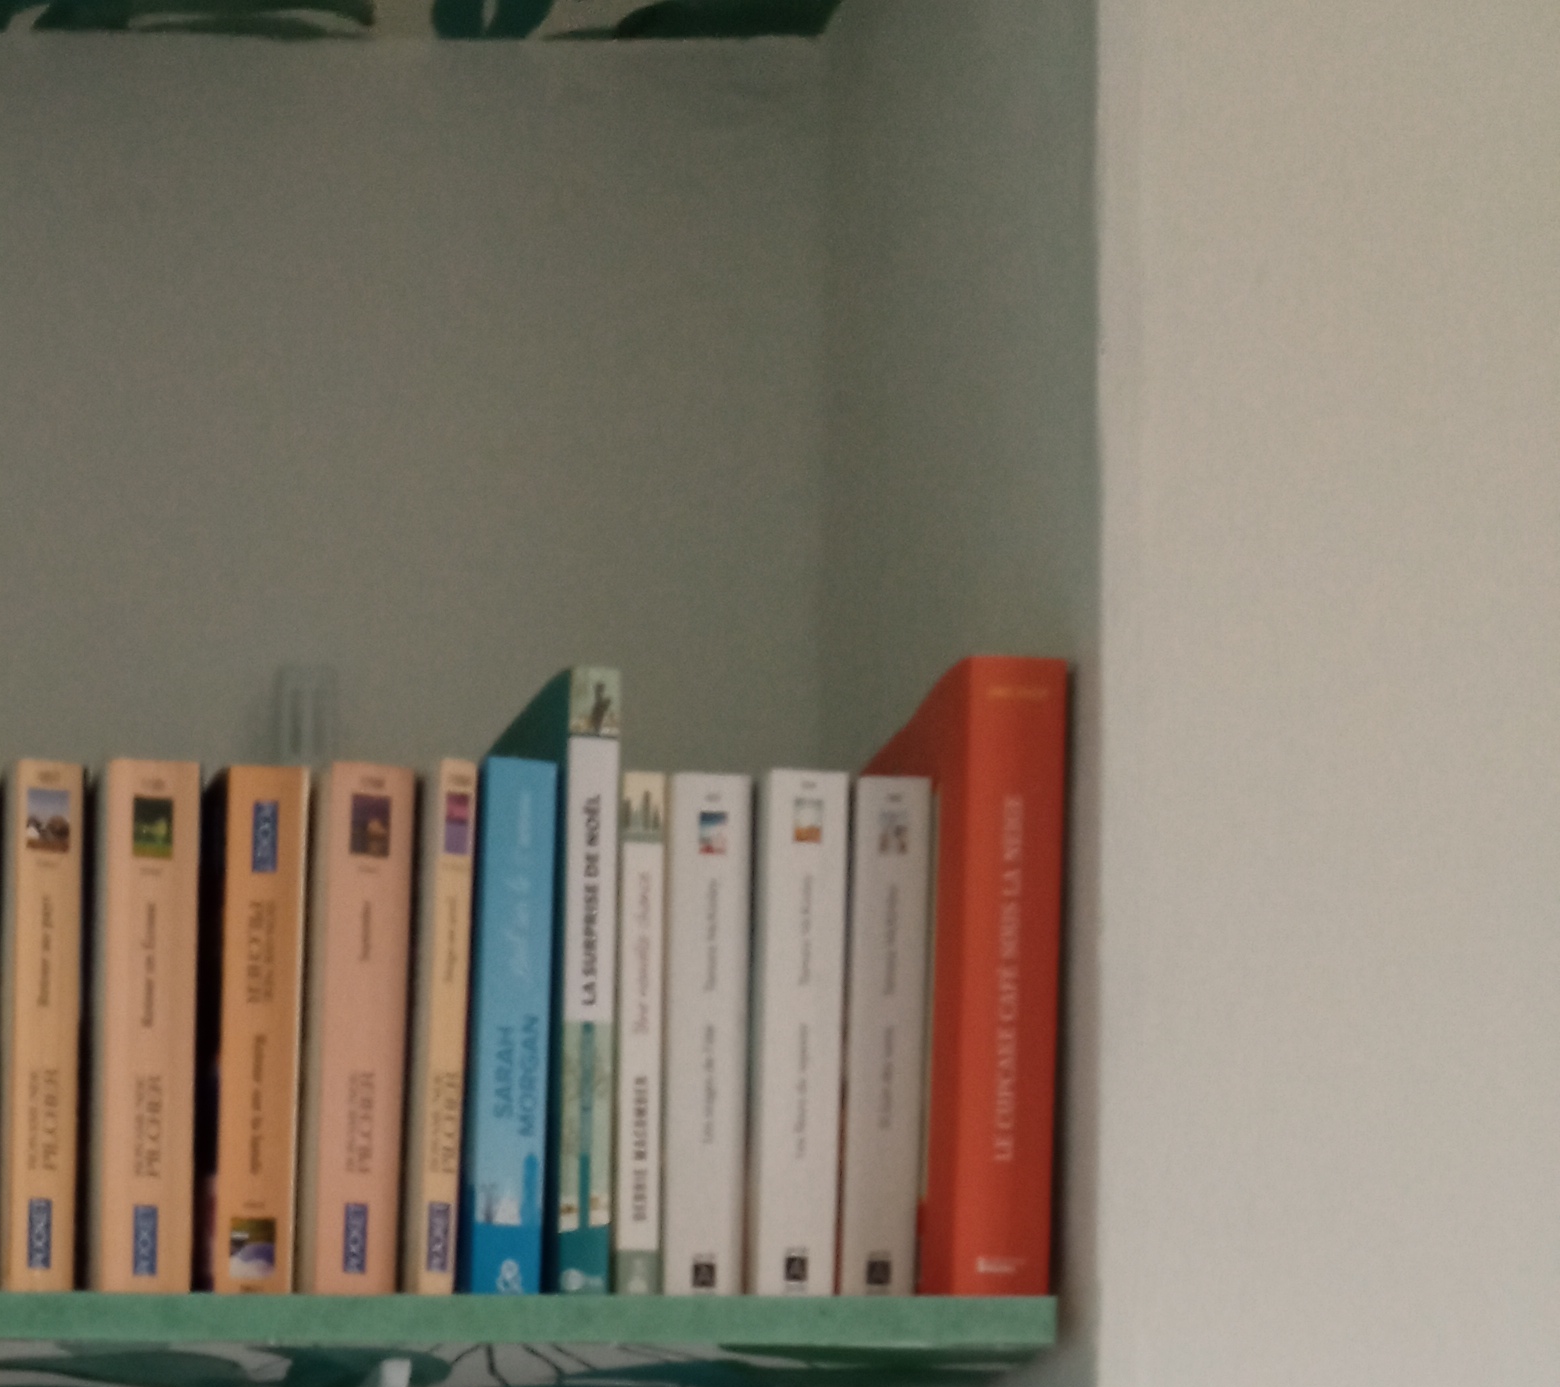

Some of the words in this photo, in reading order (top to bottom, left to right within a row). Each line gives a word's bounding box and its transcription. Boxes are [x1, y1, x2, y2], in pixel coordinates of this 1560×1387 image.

[580, 792, 602, 847] NOËL
[1000, 794, 1024, 862] NEIGE
[582, 851, 601, 878] DE
[1000, 866, 1023, 897] LA
[580, 882, 601, 977] SURPRISE
[581, 981, 599, 1007] LA
[992, 963, 1019, 1022] CAFÉ
[492, 1025, 515, 1119] SARAH
[515, 1014, 541, 1139] MORGAN
[993, 1026, 1017, 1134] CUPCAKE
[41, 1069, 60, 1170] PILCHER
[145, 1075, 163, 1179] PILCHER
[358, 1071, 376, 1175] PILCHER
[993, 1138, 1012, 1163] LE
